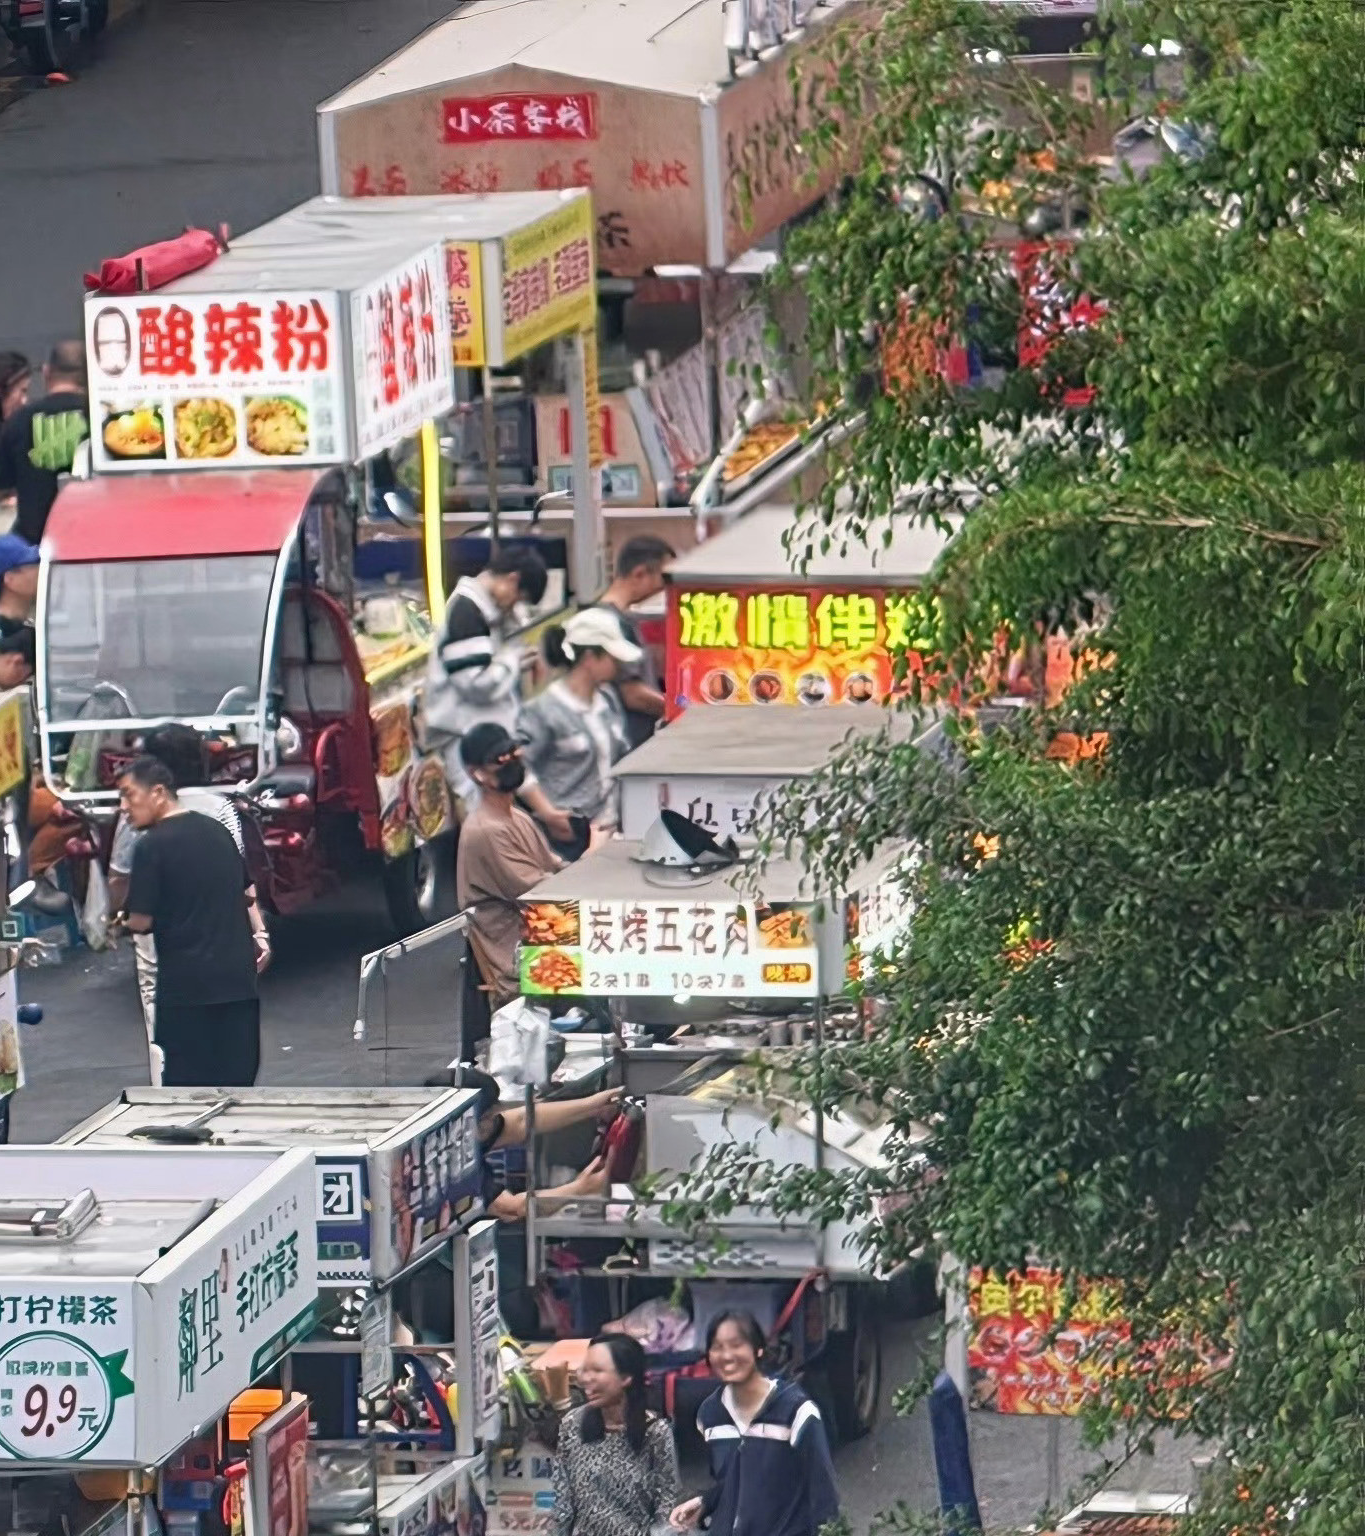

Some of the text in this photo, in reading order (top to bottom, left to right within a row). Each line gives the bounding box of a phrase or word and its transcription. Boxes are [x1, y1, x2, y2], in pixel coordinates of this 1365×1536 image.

[137, 299, 330, 376] 酸辣粉
[587, 902, 749, 958] 炭烤五花肉
[21, 1384, 77, 1437] 9.9
[78, 1407, 100, 1432] 元
